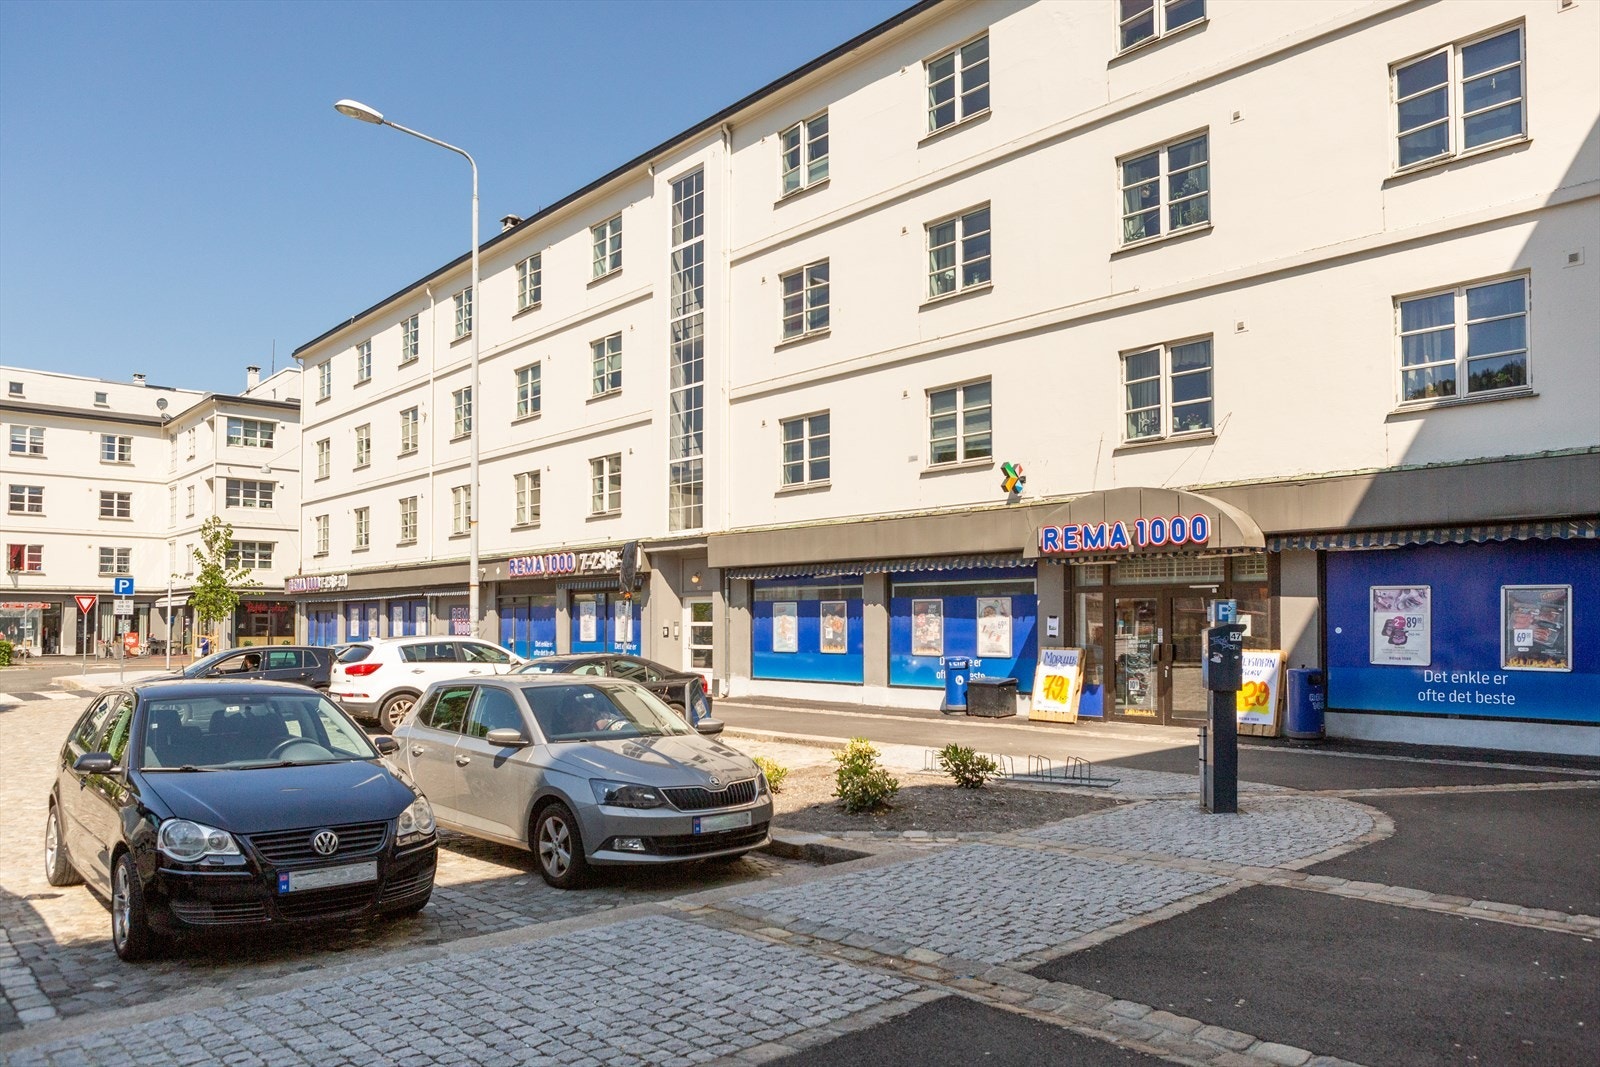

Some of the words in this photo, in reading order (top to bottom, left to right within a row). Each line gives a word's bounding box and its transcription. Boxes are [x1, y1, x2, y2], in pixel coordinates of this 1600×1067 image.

[1041, 520, 1131, 553] REMA
[1134, 514, 1211, 547] 1000
[509, 554, 545, 577] REMA
[545, 551, 575, 575] 1000
[119, 580, 130, 592] P
[452, 607, 470, 621] REM
[1219, 604, 1230, 620] P
[973, 659, 982, 667] er
[1424, 669, 1448, 683] Det
[1451, 671, 1490, 684] enkle
[1493, 674, 1508, 685] er
[1044, 674, 1065, 700] 79
[1244, 681, 1270, 707] 29
[1418, 688, 1446, 702] ofte
[1448, 689, 1472, 703] det
[1475, 690, 1516, 705] beste
